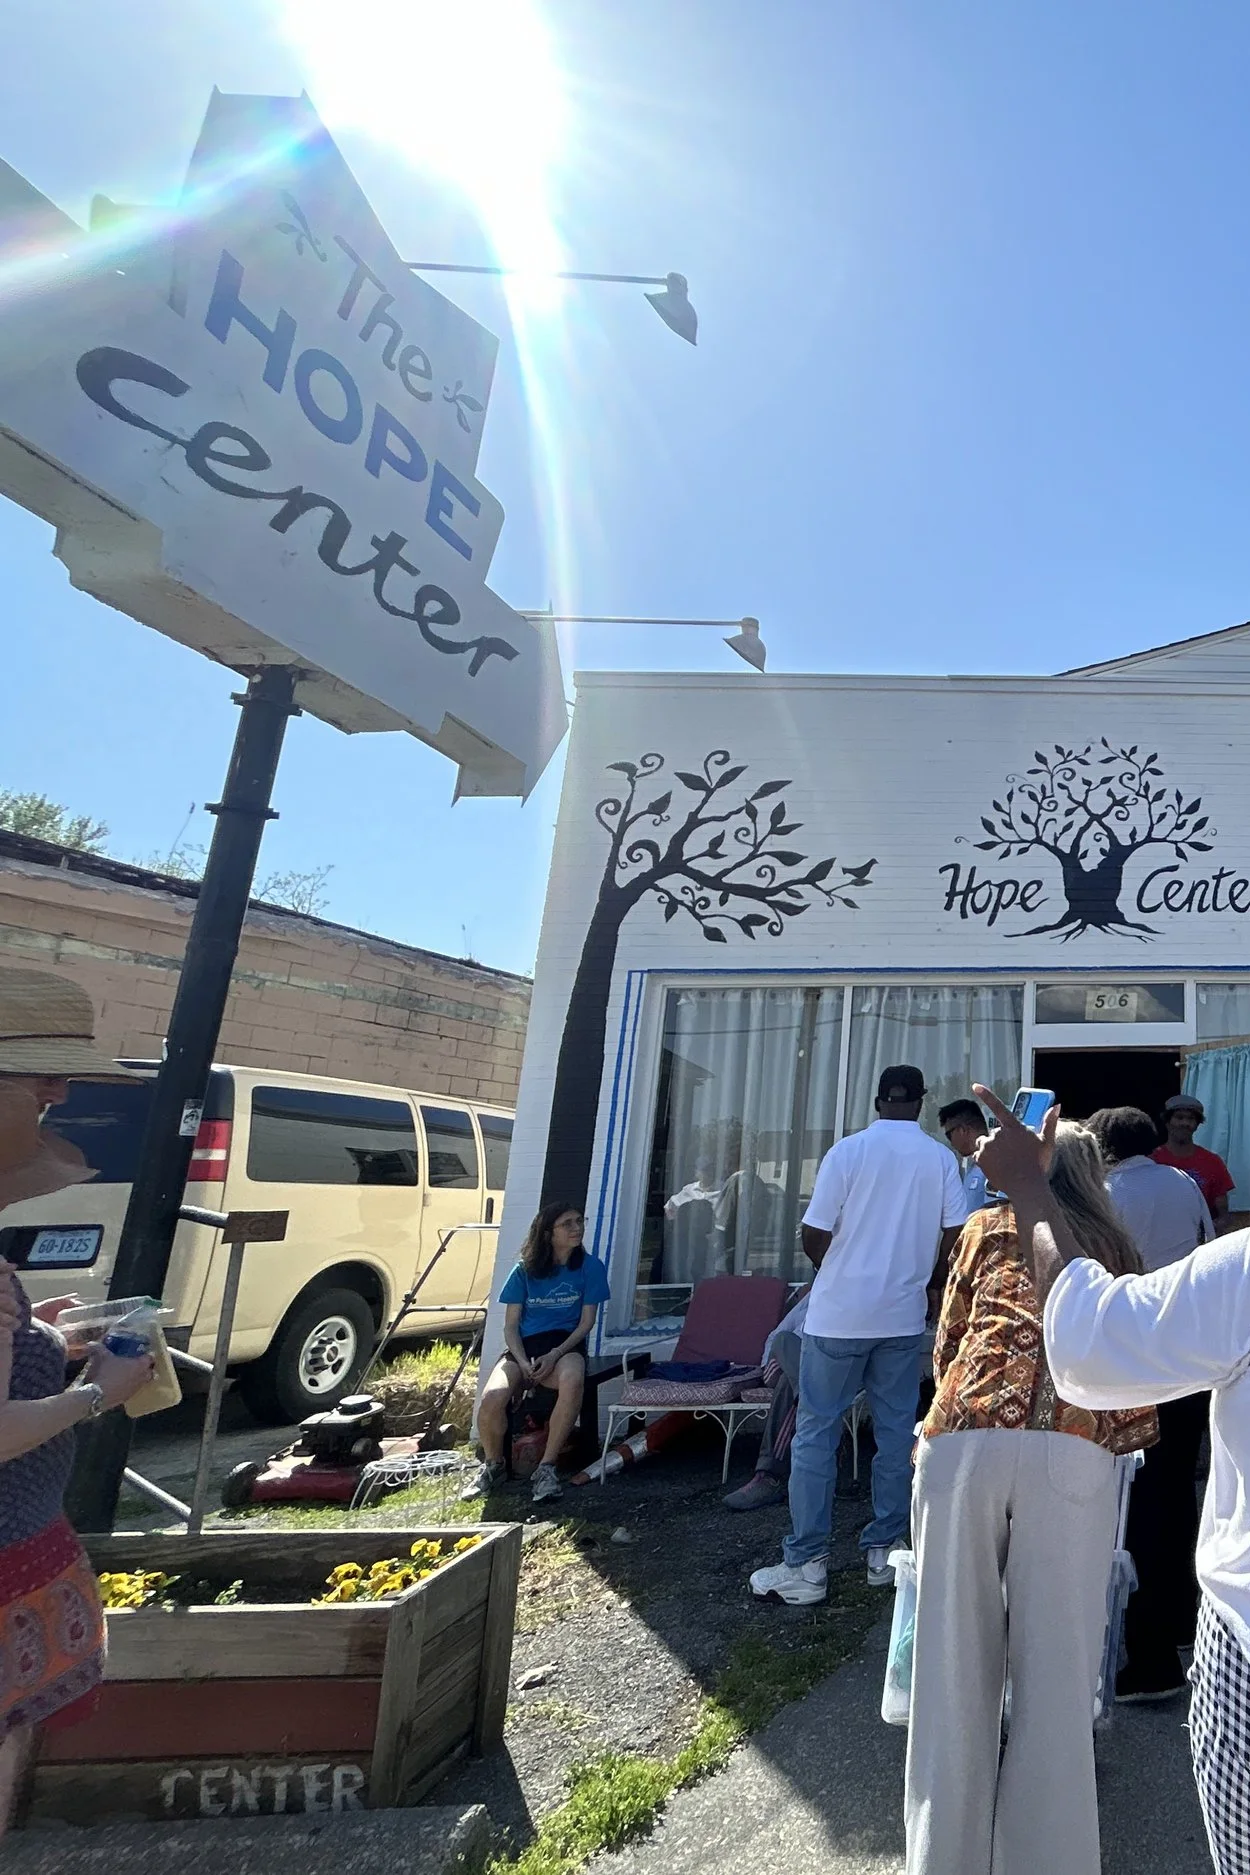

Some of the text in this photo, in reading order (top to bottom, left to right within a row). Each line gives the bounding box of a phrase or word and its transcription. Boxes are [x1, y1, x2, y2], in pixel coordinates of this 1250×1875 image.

[333, 234, 433, 402] The
[204, 248, 482, 561] HOPE
[75, 346, 520, 677] Center
[938, 862, 1050, 928] Hope
[1094, 993, 1130, 1009] 506
[159, 1763, 365, 1815] CENTER
